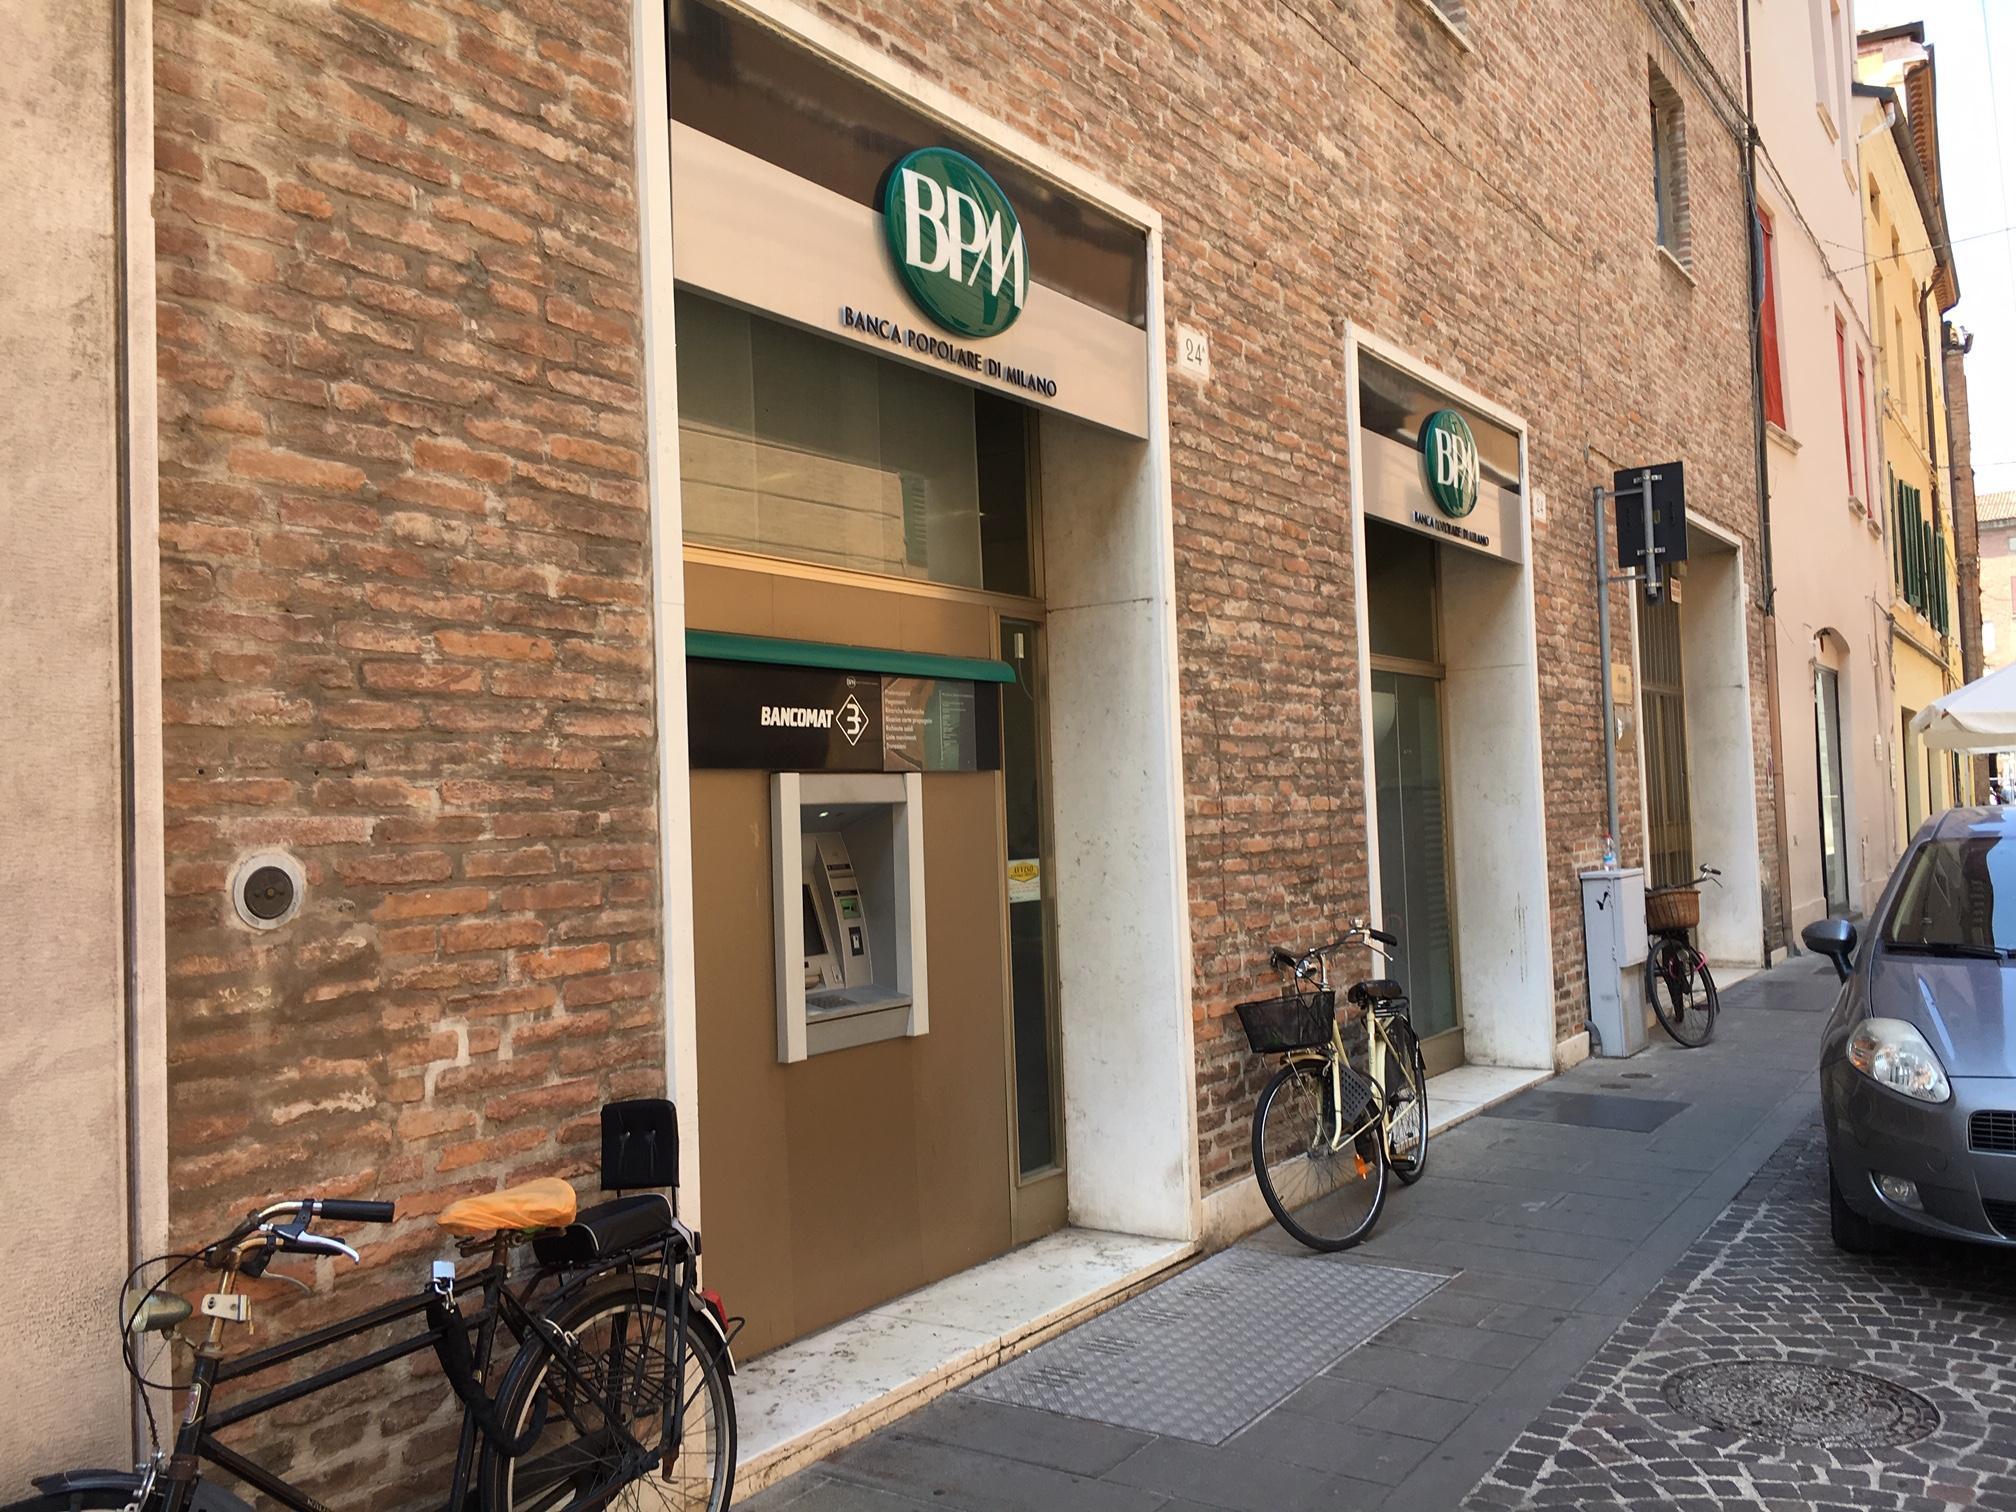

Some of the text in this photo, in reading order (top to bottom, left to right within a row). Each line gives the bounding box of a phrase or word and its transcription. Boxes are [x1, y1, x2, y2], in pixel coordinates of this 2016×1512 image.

[902, 167, 1024, 310] BPM
[843, 306, 1057, 397] BANCA POPOLARE DI MILANO
[761, 706, 834, 728] BANCOMAT
